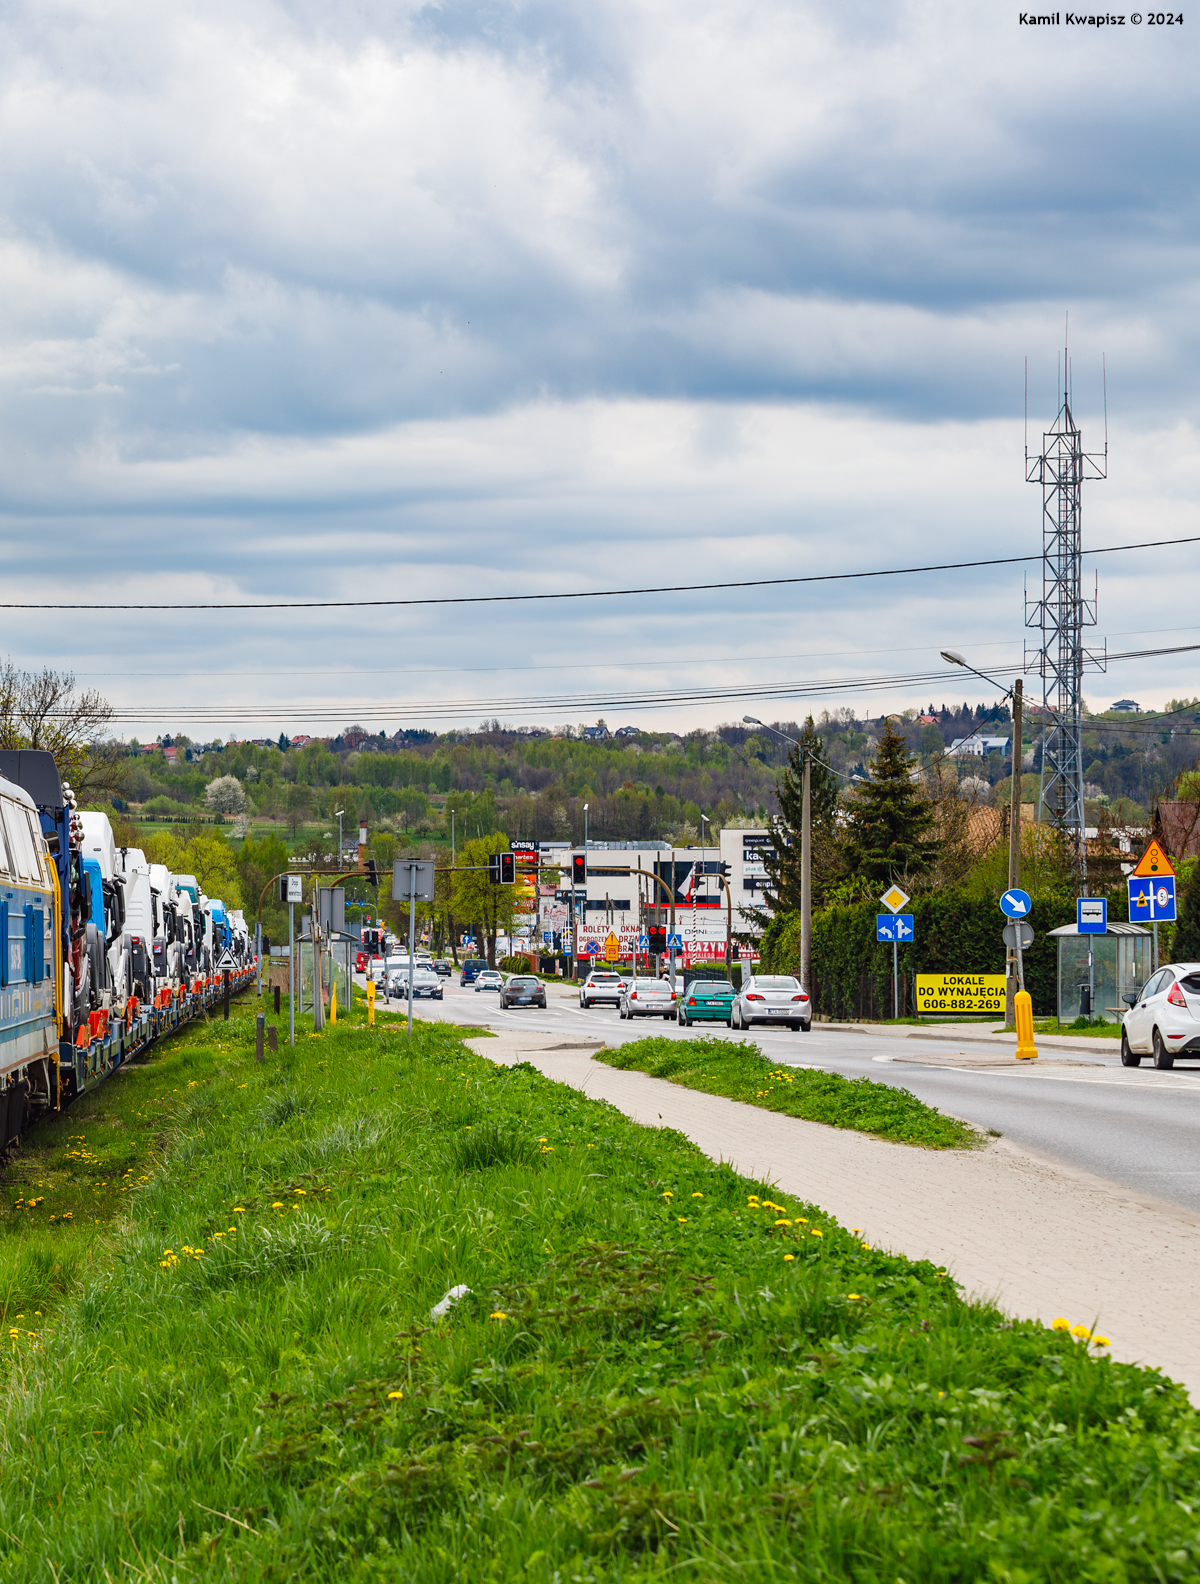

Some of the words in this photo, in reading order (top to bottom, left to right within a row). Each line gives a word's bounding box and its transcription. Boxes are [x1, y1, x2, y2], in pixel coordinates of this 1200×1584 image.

[511, 840, 535, 850] sinsay
[755, 881, 774, 889] empi
[583, 925, 610, 933] ROLETY
[620, 925, 641, 933] OKNA
[943, 976, 985, 985] LOKALE
[918, 987, 935, 996] DO
[938, 987, 1006, 999] WYNAJĘCIA
[923, 999, 1001, 1009] 606-882-269
